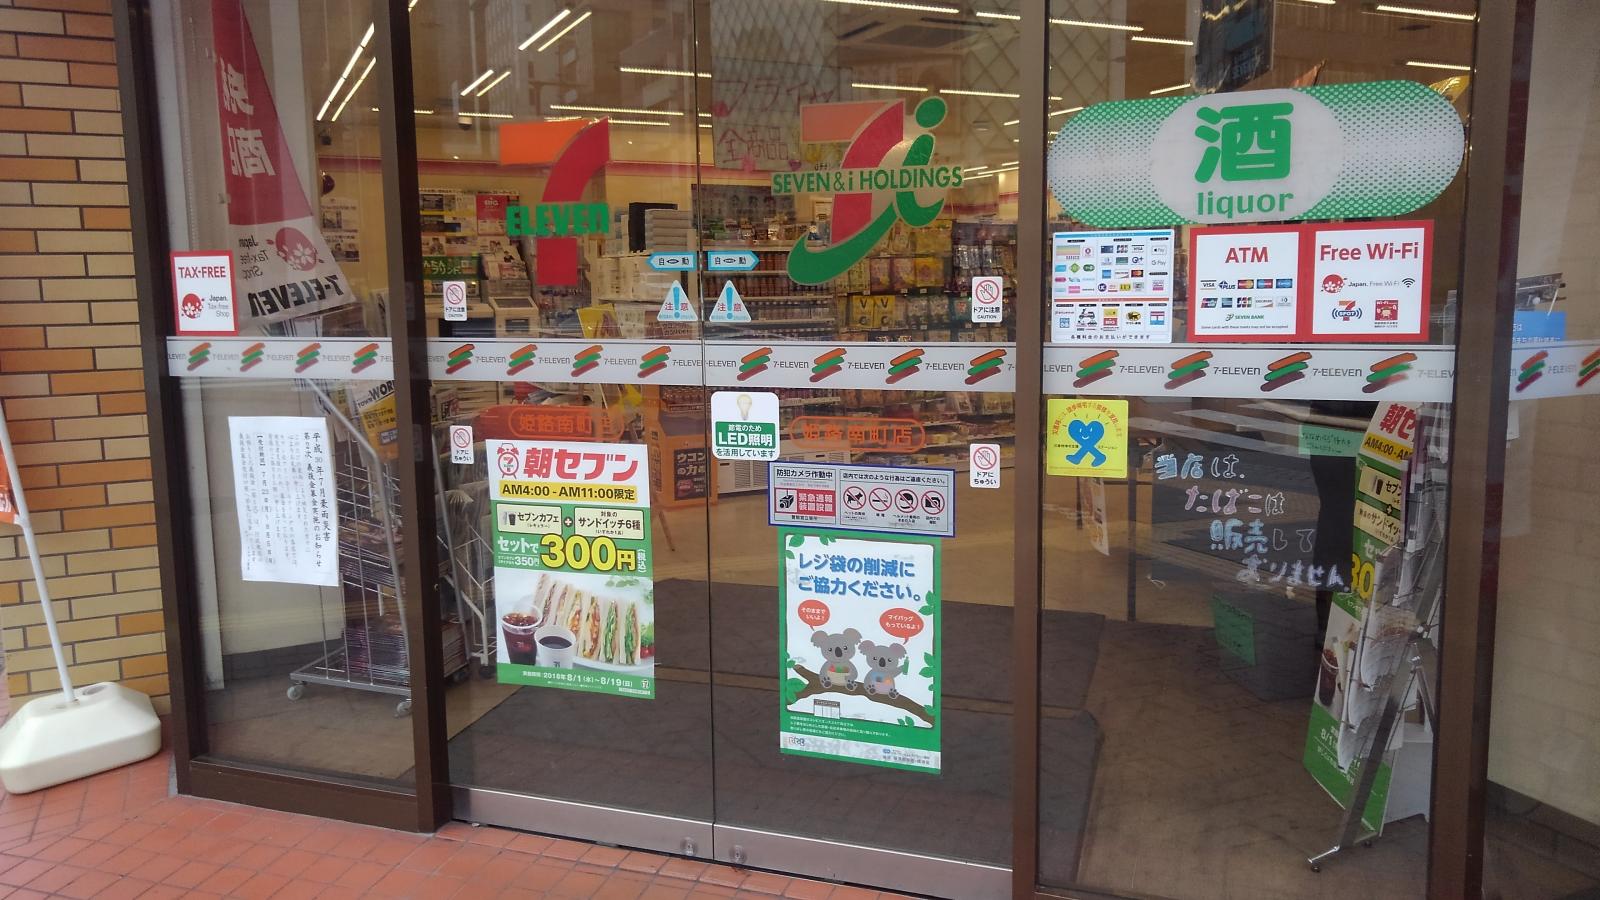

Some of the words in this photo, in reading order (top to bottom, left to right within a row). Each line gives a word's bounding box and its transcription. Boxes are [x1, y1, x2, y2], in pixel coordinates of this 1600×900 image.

[1194, 102, 1294, 184] 酒
[773, 172, 831, 194] SEVEN
[833, 171, 845, 191] &
[848, 170, 853, 190] i
[860, 166, 962, 190] HOLDINGS
[1197, 191, 1294, 218] liquor
[1225, 247, 1268, 263] ATM
[1320, 244, 1361, 261] Free
[1366, 242, 1419, 260] Wi-Fi
[178, 266, 226, 278] TAX-FREE
[973, 306, 1000, 314] ドアに注意
[728, 424, 762, 432] 節電のため
[718, 432, 773, 447] LED照明
[716, 449, 775, 458] を活用しています
[524, 447, 638, 481] 朝セブン
[776, 469, 833, 479] 防犯カメラ作動中
[502, 484, 550, 497] AM4:00
[558, 486, 635, 501] AM11:00限定
[1185, 486, 1285, 517] たばこは
[518, 511, 559, 523] セブンカフェ
[578, 517, 641, 531] サンドイッチ6種
[1209, 518, 1316, 554] 販売して
[498, 536, 538, 554] セットで
[540, 533, 637, 571] 300円
[799, 552, 915, 578] レジ袋の削減に
[798, 575, 921, 602] ご協力ください。
[888, 614, 914, 622] マイバッグ
